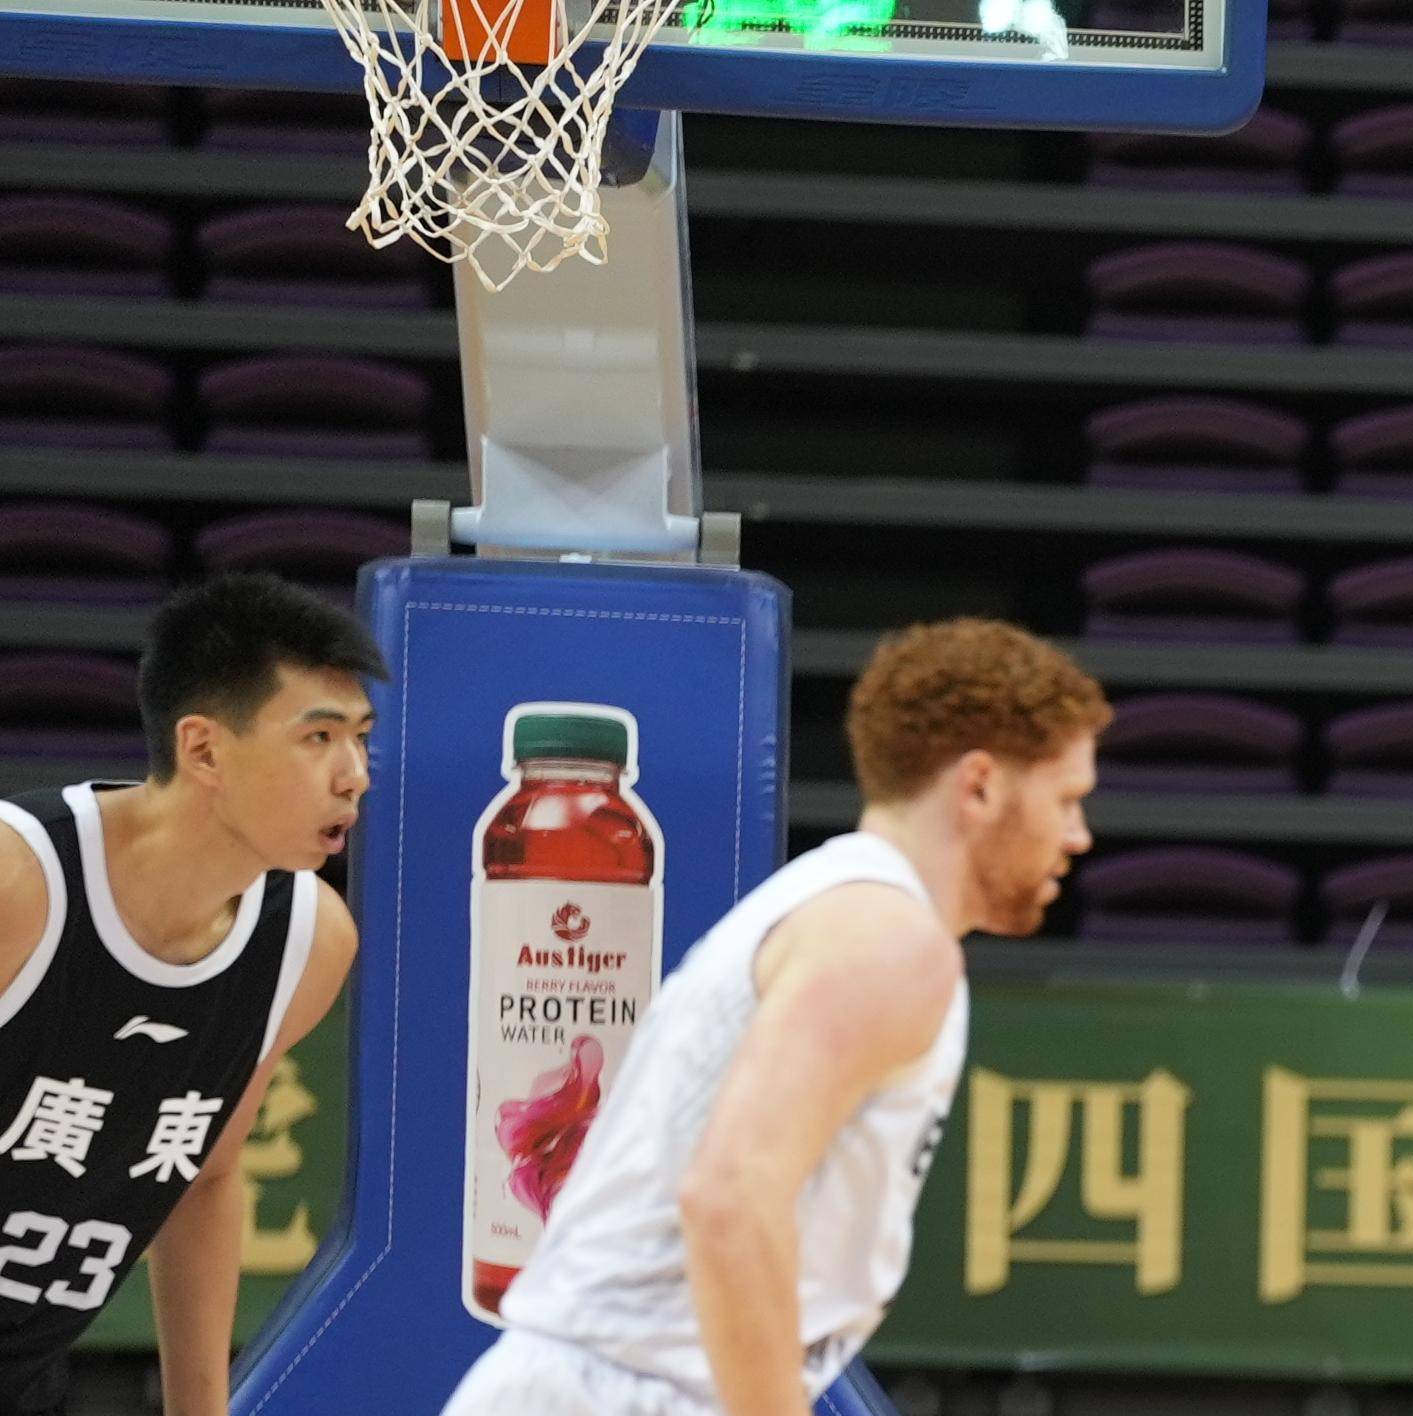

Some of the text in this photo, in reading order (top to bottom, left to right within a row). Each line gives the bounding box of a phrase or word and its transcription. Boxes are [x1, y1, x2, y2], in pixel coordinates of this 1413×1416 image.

[516, 943, 628, 974] Austiger
[500, 995, 637, 1026] PROTEIN
[501, 1023, 566, 1045] WATER
[0, 1075, 225, 1183] 廣東
[0, 1210, 133, 1311] 23
